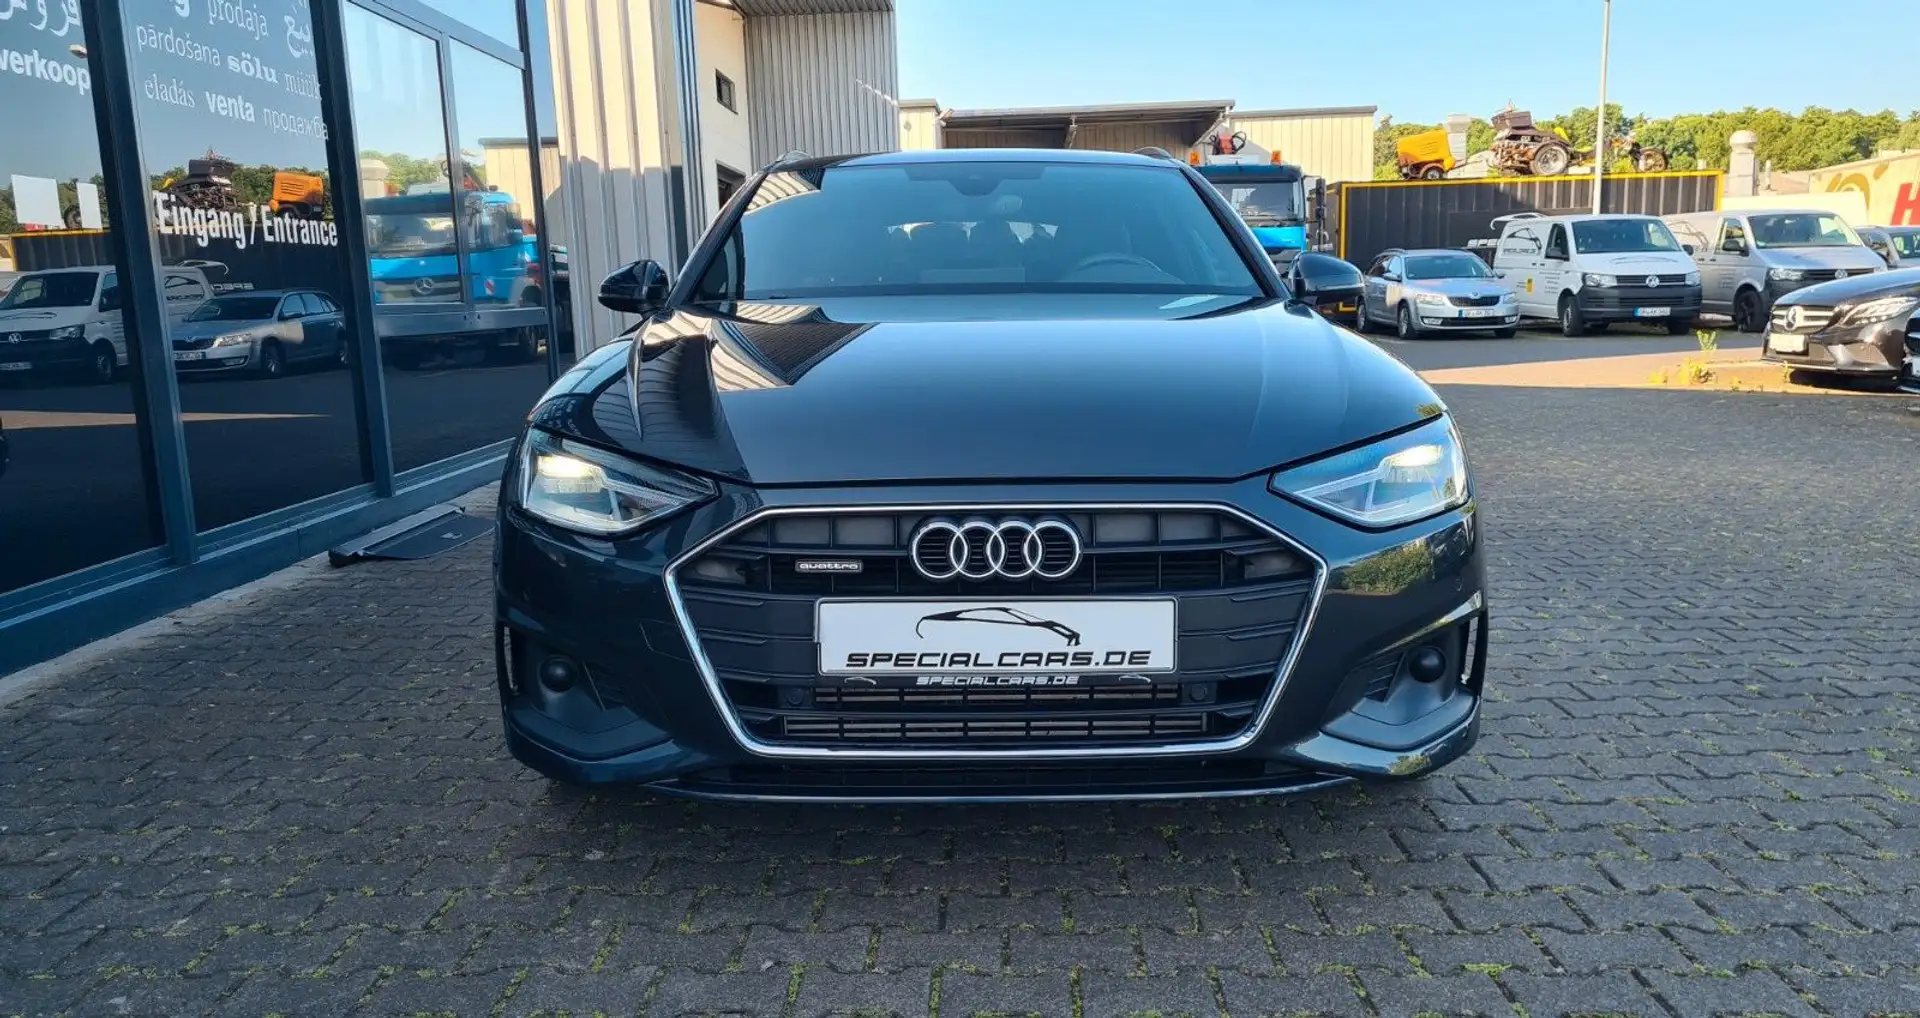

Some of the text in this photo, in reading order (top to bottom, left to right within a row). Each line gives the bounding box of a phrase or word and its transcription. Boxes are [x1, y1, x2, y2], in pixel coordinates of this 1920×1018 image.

[207, 0, 269, 41] prodaja
[0, 48, 91, 95] verkoop
[136, 24, 221, 67] pārdošana
[227, 52, 279, 84] sölu
[144, 73, 255, 123] eladás venta
[156, 190, 246, 250] Eingang
[261, 204, 338, 247] Entrance
[799, 562, 859, 572] quattro
[846, 650, 1151, 667] SPECIALCARS.DE
[916, 675, 1079, 686] SPECIALCARS.DE
